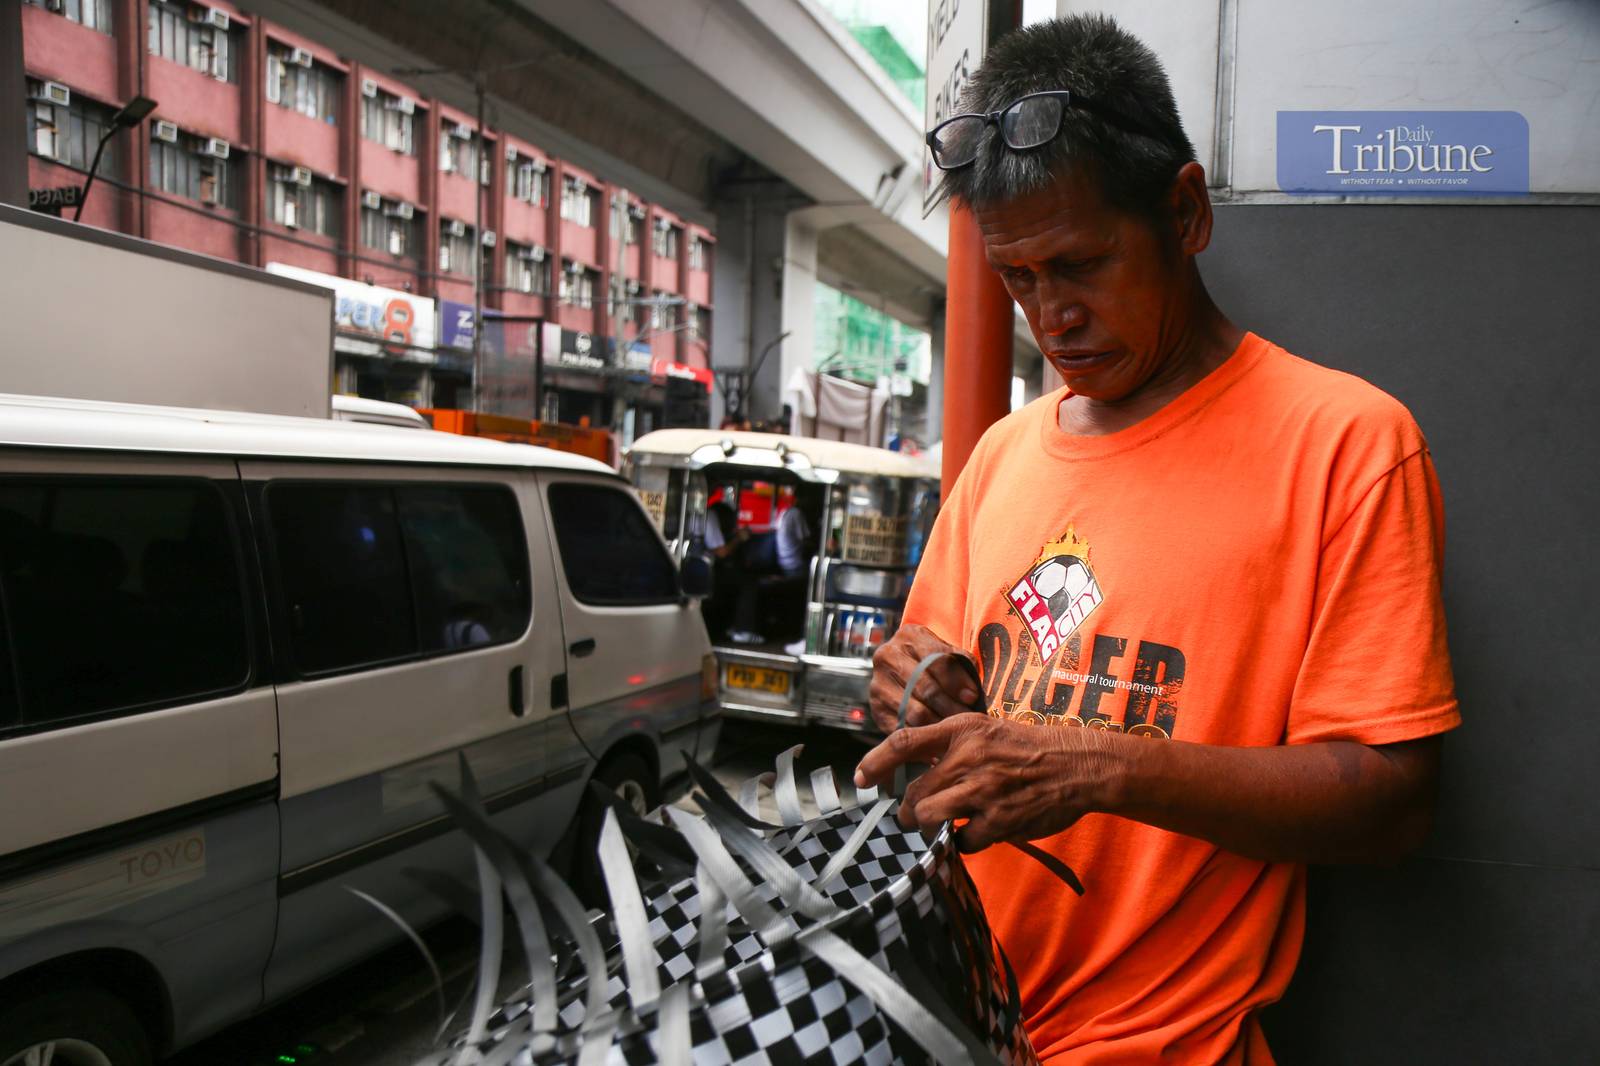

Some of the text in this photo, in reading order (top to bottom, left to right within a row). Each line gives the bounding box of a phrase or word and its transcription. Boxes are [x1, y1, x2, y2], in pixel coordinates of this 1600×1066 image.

[1010, 579, 1057, 663] FLAG
[1057, 582, 1097, 639] CITY
[978, 622, 1186, 739] OCCER
[1052, 668, 1164, 696] inaugural tournament
